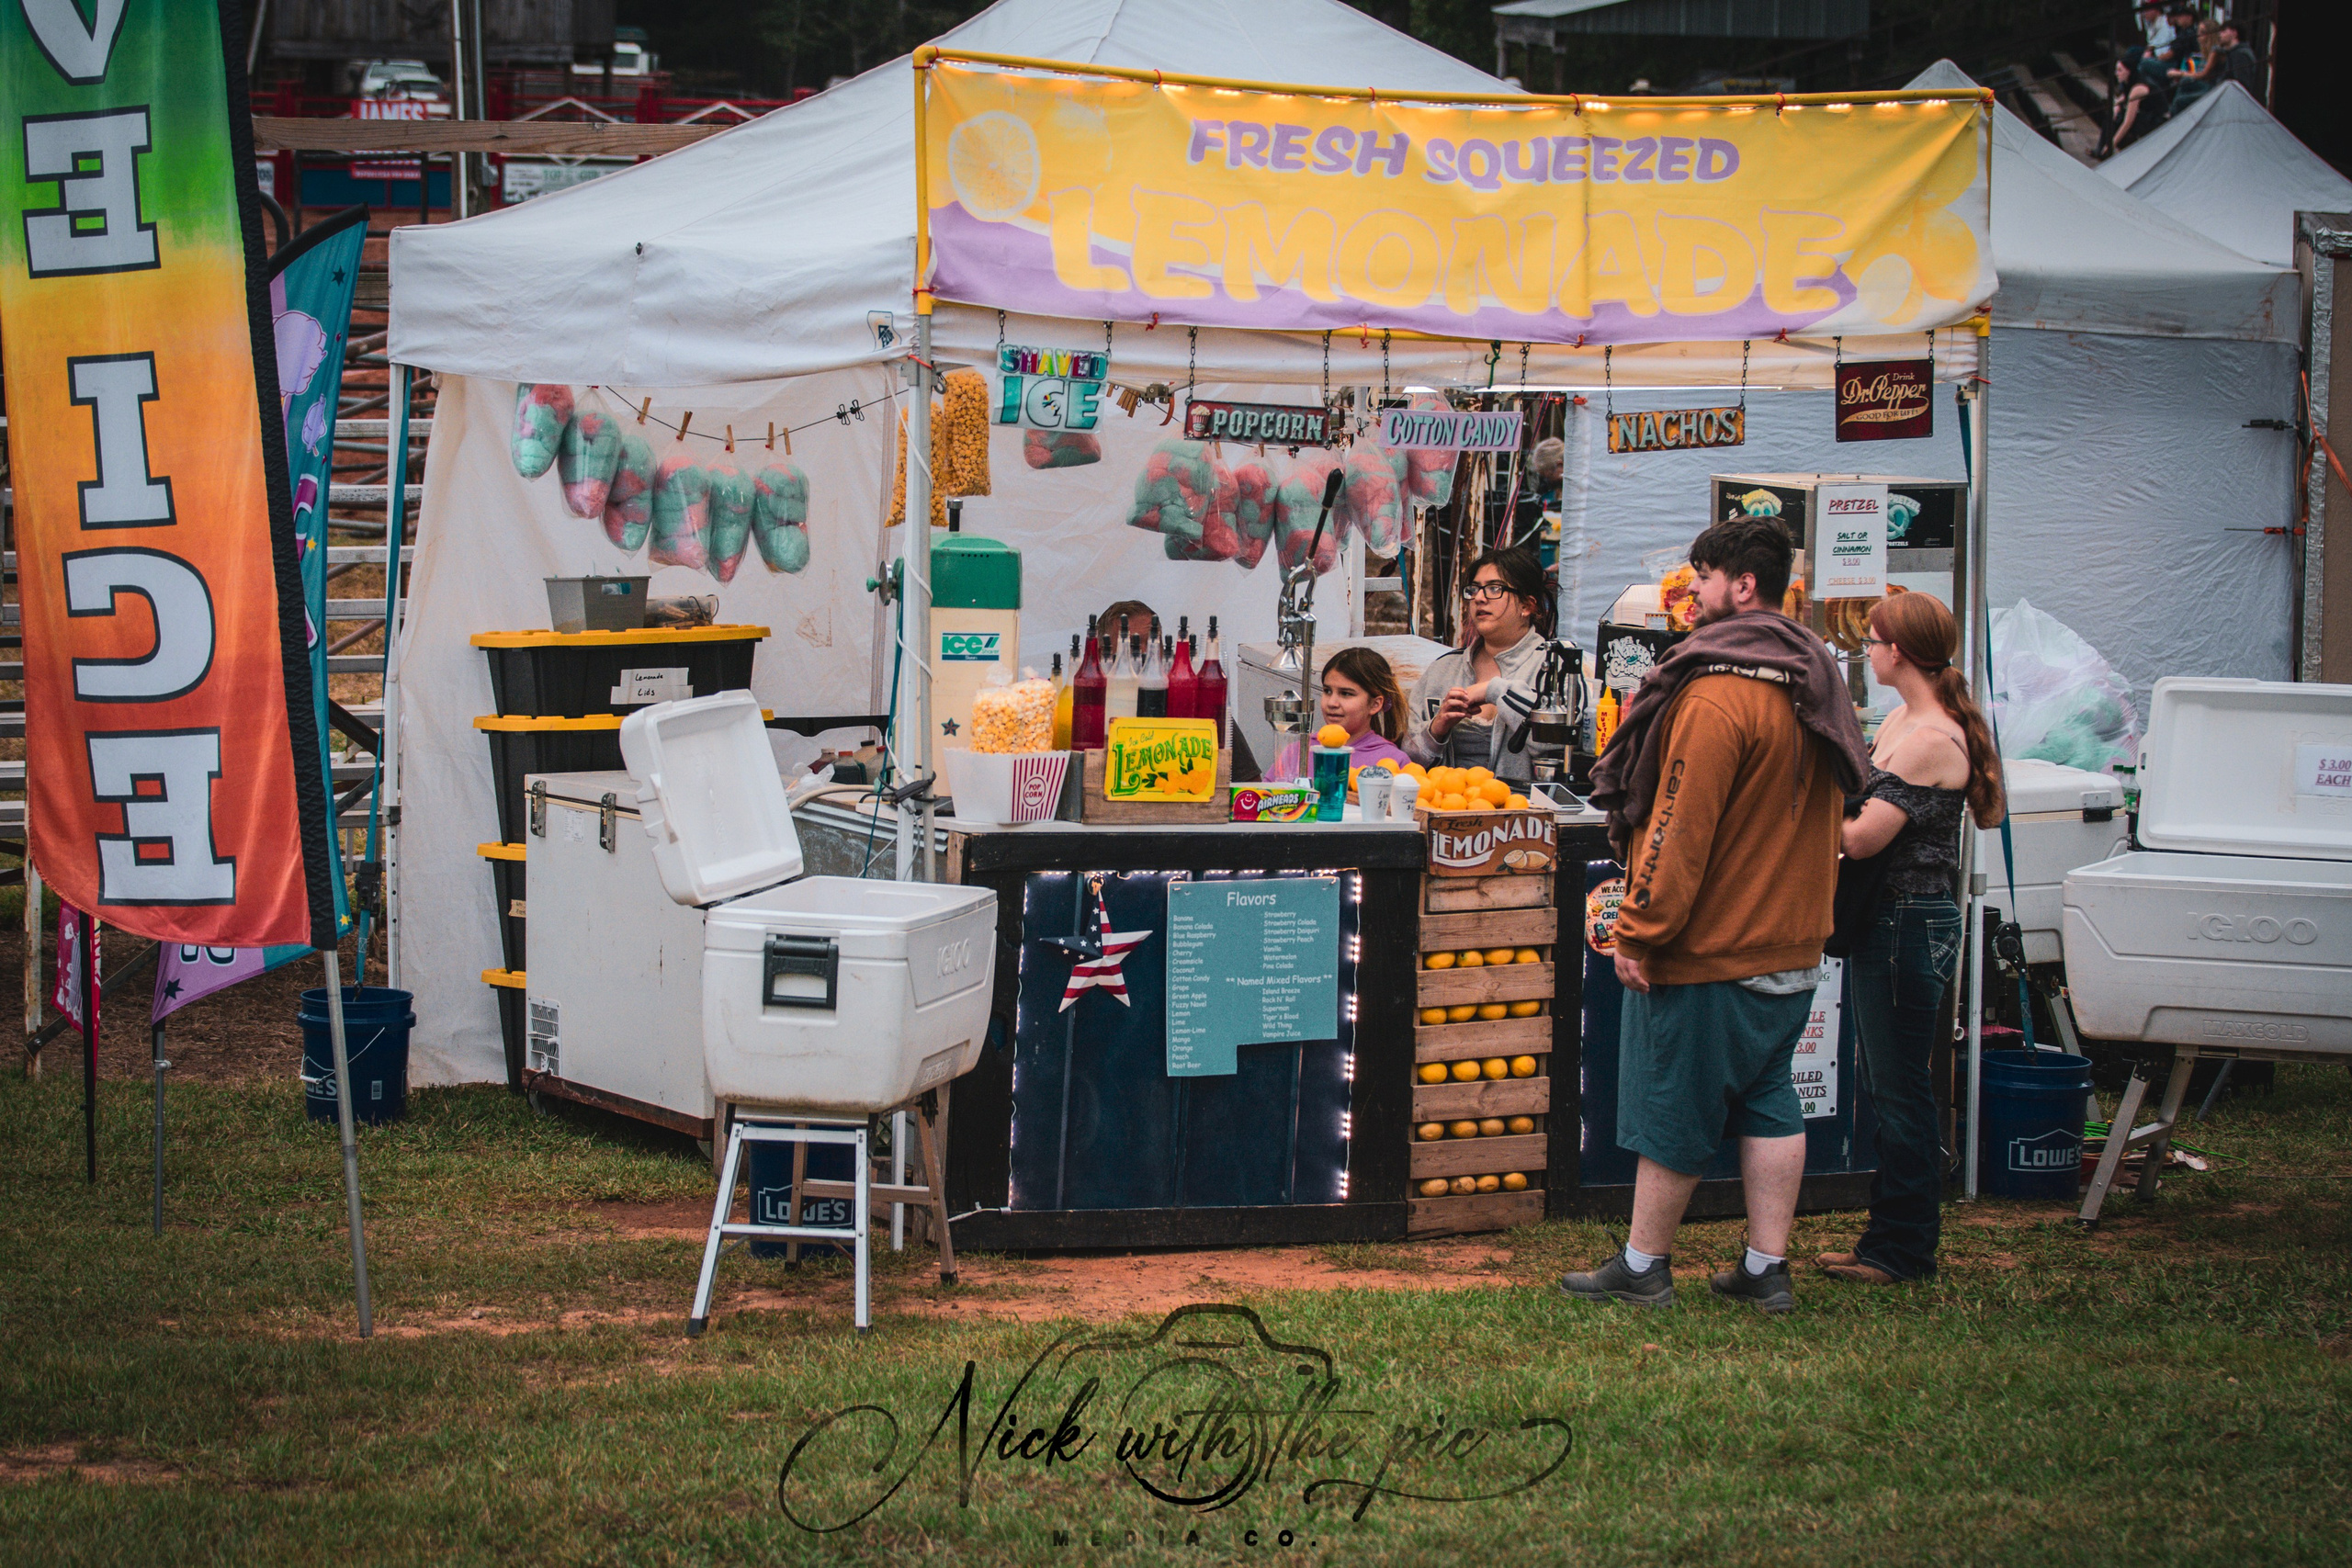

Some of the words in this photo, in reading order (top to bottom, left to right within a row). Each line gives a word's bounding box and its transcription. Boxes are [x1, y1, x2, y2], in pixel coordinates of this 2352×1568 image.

[1188, 118, 1409, 178] FRESH
[1423, 134, 1741, 191] SQUEEZED
[1048, 184, 1847, 319] LEMONADE
[1000, 344, 1108, 379] SHAVED
[1893, 372, 1916, 381] Drink
[1000, 375, 1101, 429] ICE
[1856, 412, 1881, 421] GOOD
[1883, 410, 1899, 419] FOR
[1212, 409, 1325, 442] POPCORN
[1387, 411, 1458, 446] COTTON
[1459, 413, 1520, 447] CANDY
[1618, 410, 1737, 450] NACHOS
[1828, 498, 1879, 512] PRETZEL
[1837, 531, 1856, 540] SALT
[1858, 531, 1868, 539] OR
[1832, 545, 1871, 553] CINNAMON
[1828, 577, 1856, 585] CHEESE
[635, 673, 663, 682] Lemonade
[638, 688, 655, 696] Lids
[1111, 733, 1213, 796] LEMONADE
[2316, 773, 2352, 786] EACH
[1024, 790, 1043, 798] CORN
[1257, 793, 1300, 813] AIRHEADS
[1442, 818, 1484, 832] Fresh
[1431, 817, 1555, 868] LEMONADE
[1611, 886, 1625, 894] ACC
[1227, 892, 1277, 907] Flavors
[1605, 899, 1623, 908] CAS
[1602, 911, 1620, 920] CRE
[2187, 912, 2318, 945] IGLOO
[1187, 931, 1216, 940] Raspberry
[1172, 941, 1204, 949] Bubblegum
[1237, 976, 1264, 986] Named
[1266, 976, 1290, 985] Mixed
[1292, 976, 1321, 984] Flavors
[1191, 992, 1207, 1000] Apple
[1277, 1021, 1293, 1030] Thing
[2203, 1019, 2309, 1043] MAXCOLD
[1262, 1031, 1284, 1039] Vampire
[1791, 1071, 1823, 1082] OILED
[2019, 1144, 2082, 1167] LOWE'S
